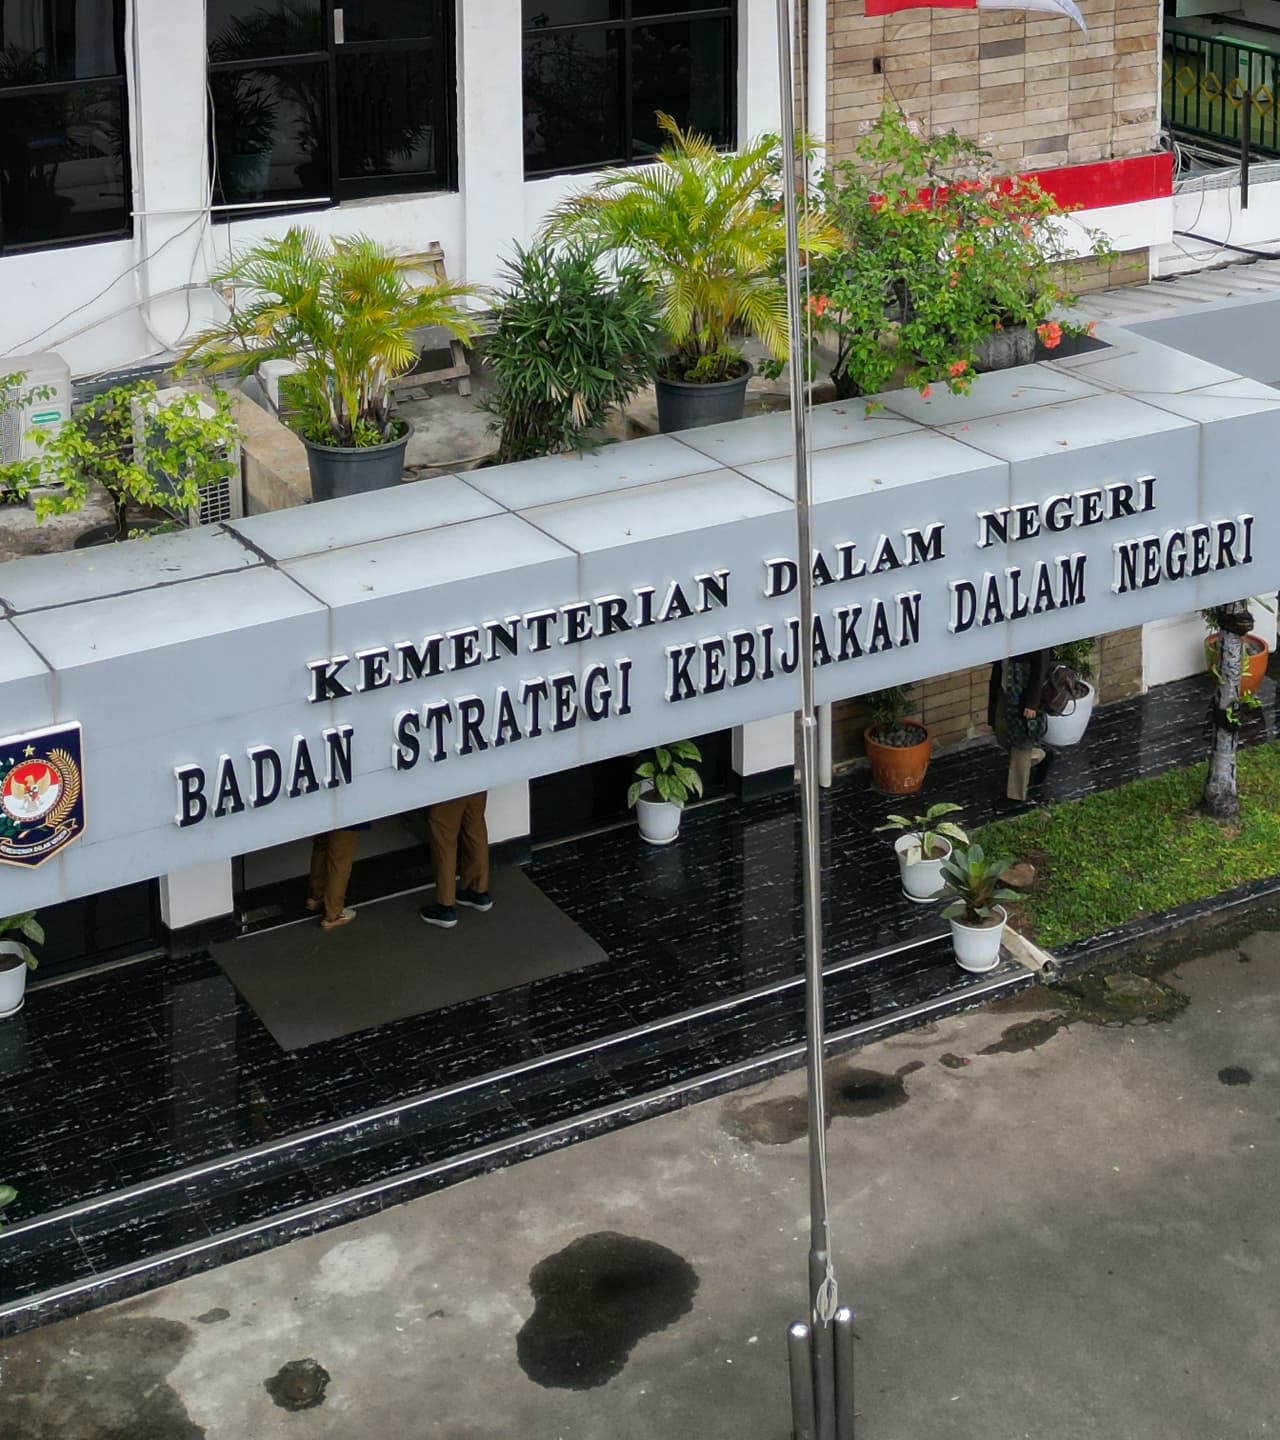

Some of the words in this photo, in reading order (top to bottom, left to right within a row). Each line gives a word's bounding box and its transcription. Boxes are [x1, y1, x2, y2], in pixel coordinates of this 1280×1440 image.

[175, 725, 354, 827] BADAN
[394, 659, 632, 770] STRATEGI
[667, 590, 922, 702] KEBIJAKAN
[951, 553, 1087, 633] DALAM
[1114, 515, 1255, 593] NEGERI
[308, 570, 731, 703] KEMENTERIAN
[765, 521, 946, 597] DALAM
[978, 476, 1157, 548] NEGERI
